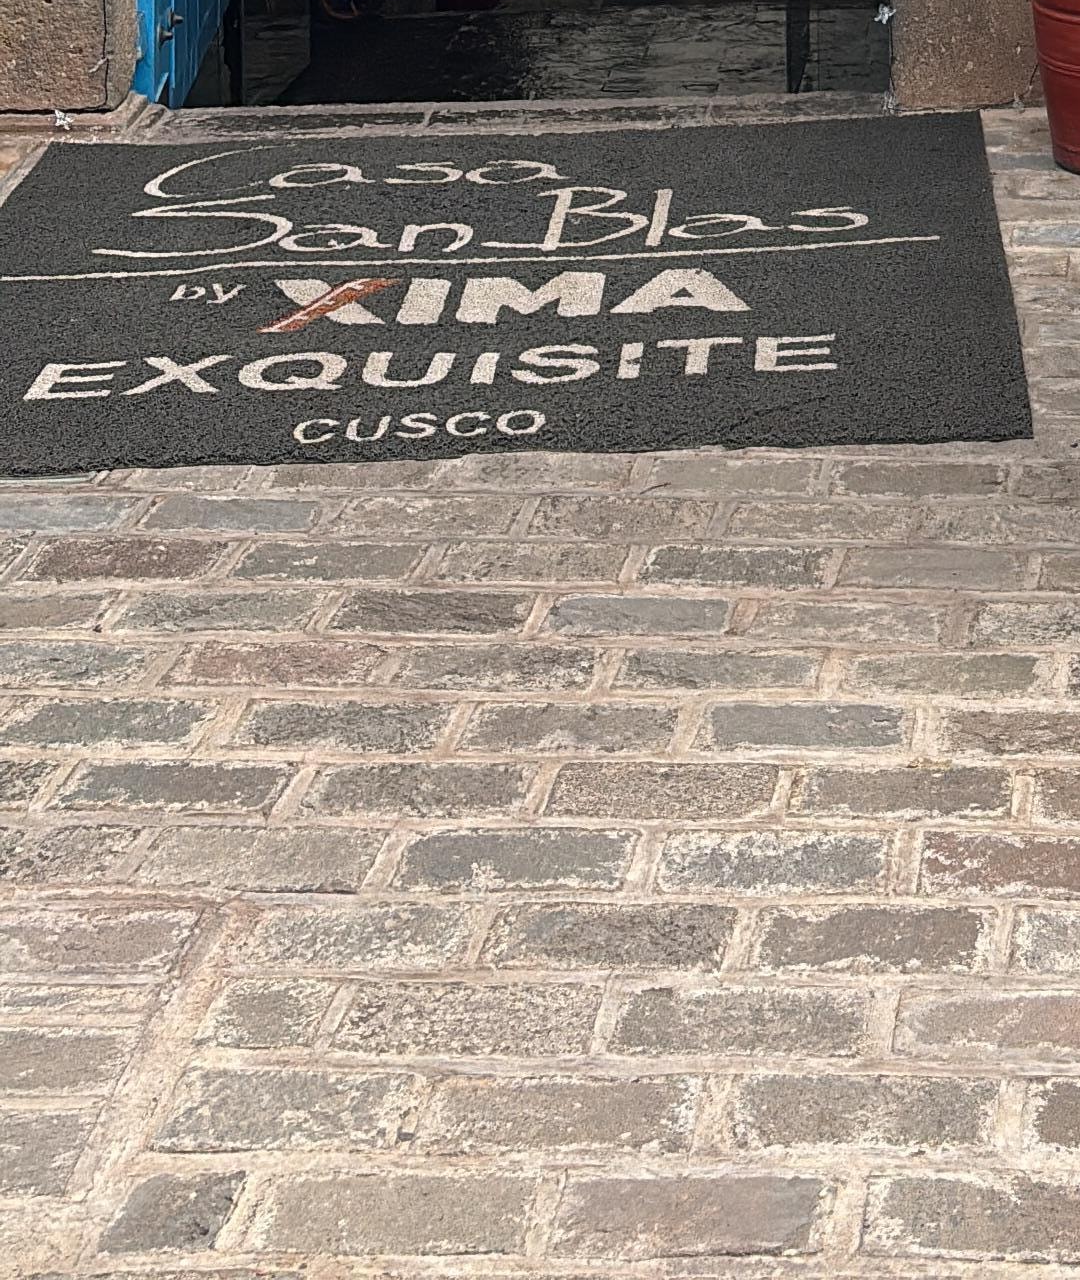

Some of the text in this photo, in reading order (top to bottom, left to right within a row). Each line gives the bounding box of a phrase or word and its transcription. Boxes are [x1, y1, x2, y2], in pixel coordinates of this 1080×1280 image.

[143, 144, 569, 197] Casa
[92, 186, 868, 258] San Blas
[169, 268, 751, 333] by XIMA
[22, 334, 838, 401] EXQUISITE
[293, 410, 546, 444] CUSCO
